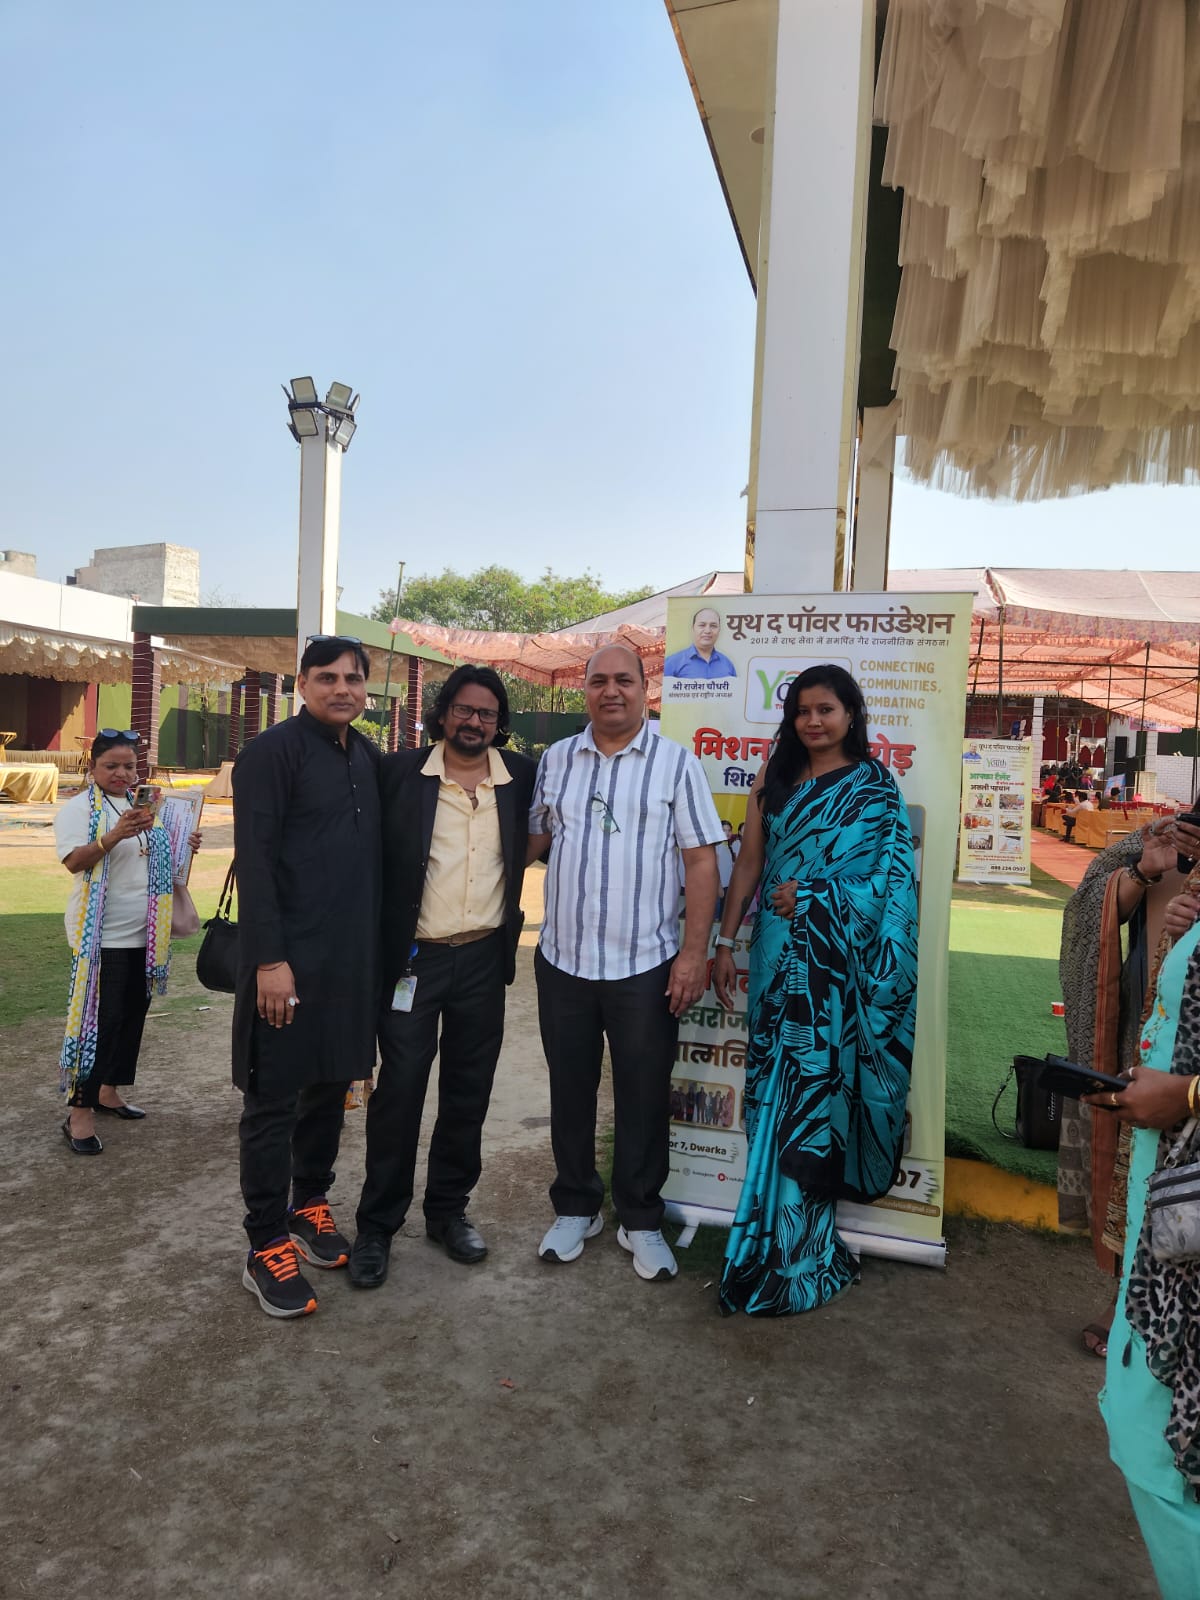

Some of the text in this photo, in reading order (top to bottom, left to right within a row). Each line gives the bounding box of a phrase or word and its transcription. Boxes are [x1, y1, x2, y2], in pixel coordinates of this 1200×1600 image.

[726, 605, 956, 640] यूथ द पॉवर फाउंडेशन
[750, 637, 769, 645] 2012
[860, 660, 935, 674] CONNECTING
[672, 681, 682, 690] श्री
[684, 681, 704, 690] राजेश
[860, 678, 942, 693] COMMUNITIES,
[865, 695, 925, 709] OMBATING
[865, 714, 912, 727] OVERTY.
[693, 727, 774, 761] मिशन
[690, 1143, 727, 1155] Dwarka
